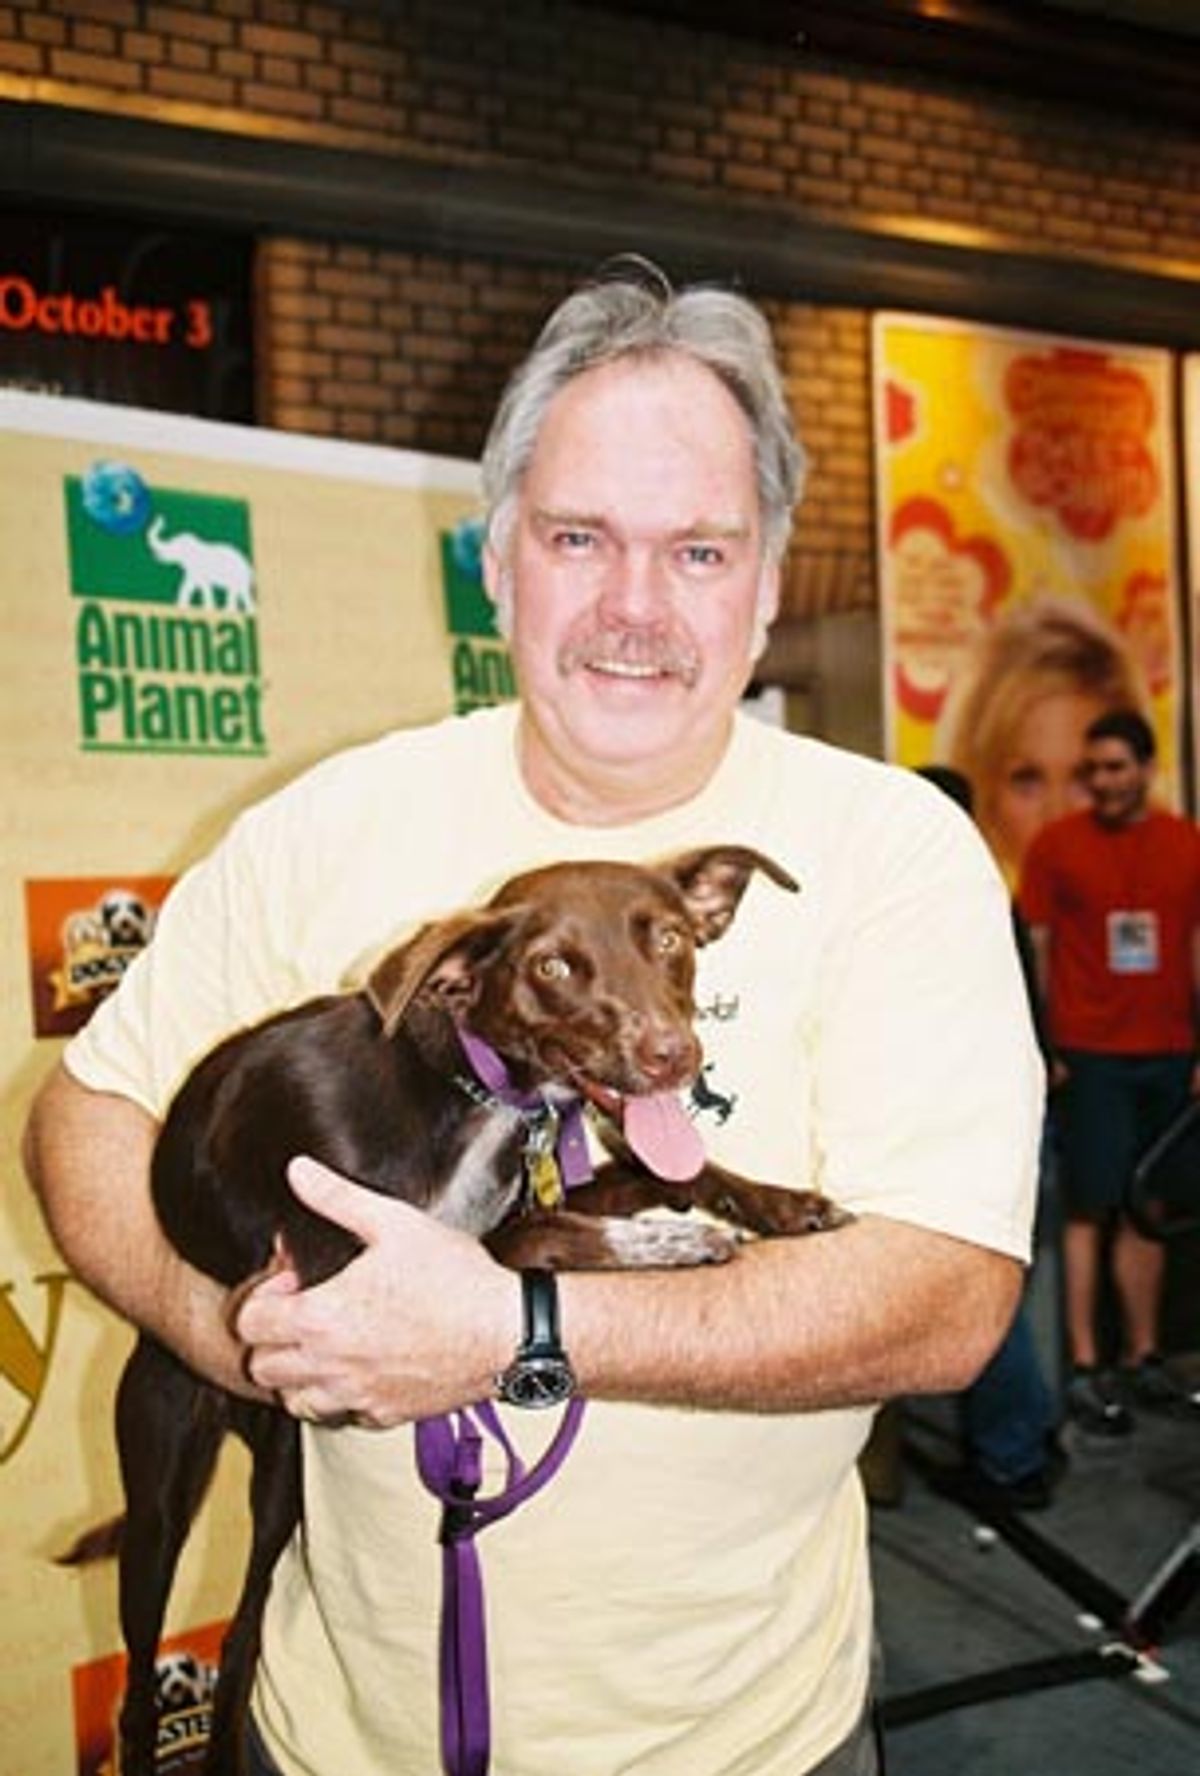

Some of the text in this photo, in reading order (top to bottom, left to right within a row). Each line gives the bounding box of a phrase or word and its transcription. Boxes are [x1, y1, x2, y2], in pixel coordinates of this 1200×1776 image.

[0, 275, 212, 347] October 3
[78, 603, 260, 676] Animal
[80, 672, 265, 744] Planet
